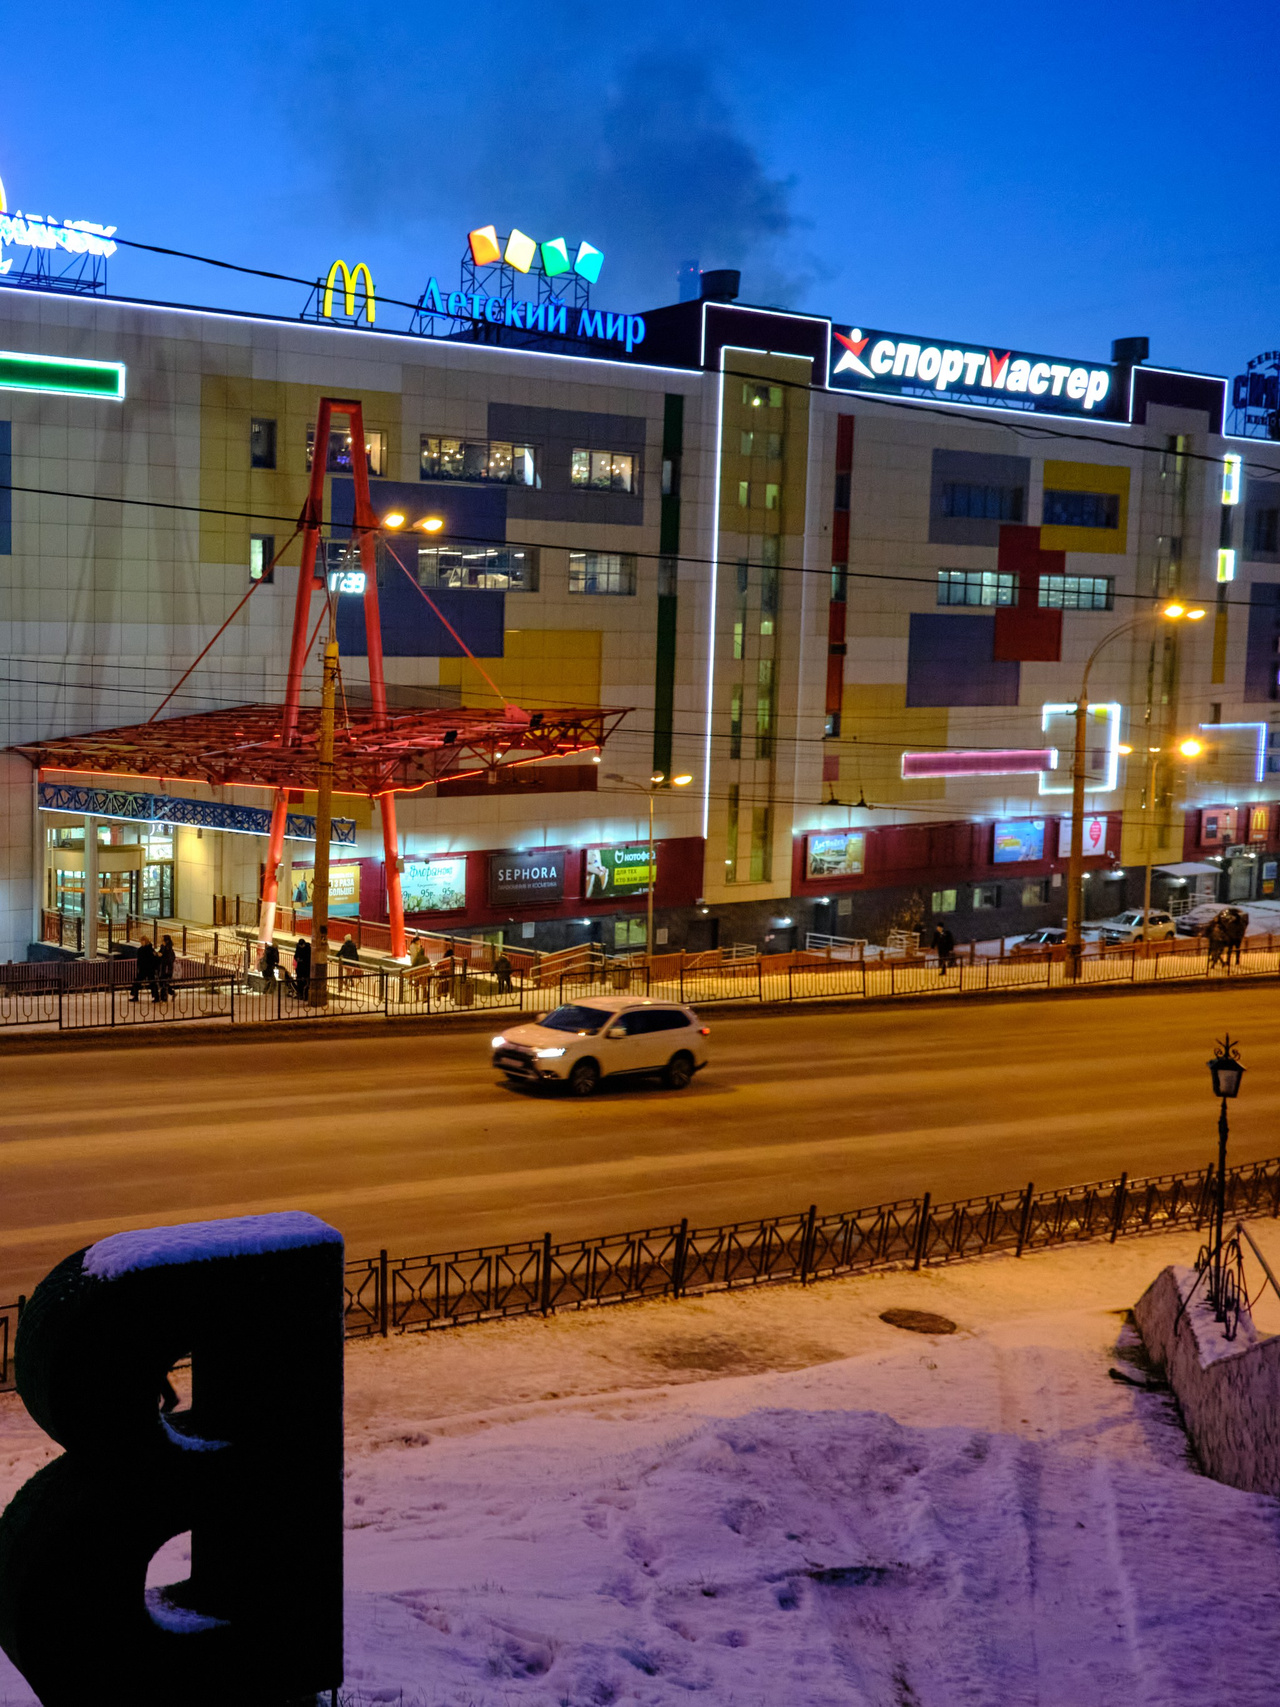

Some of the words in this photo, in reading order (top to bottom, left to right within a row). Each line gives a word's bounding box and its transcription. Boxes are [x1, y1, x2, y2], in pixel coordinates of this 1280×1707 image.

[418, 276, 568, 336] Детский
[577, 308, 646, 353] мир
[498, 866, 557, 881] SEPHORA
